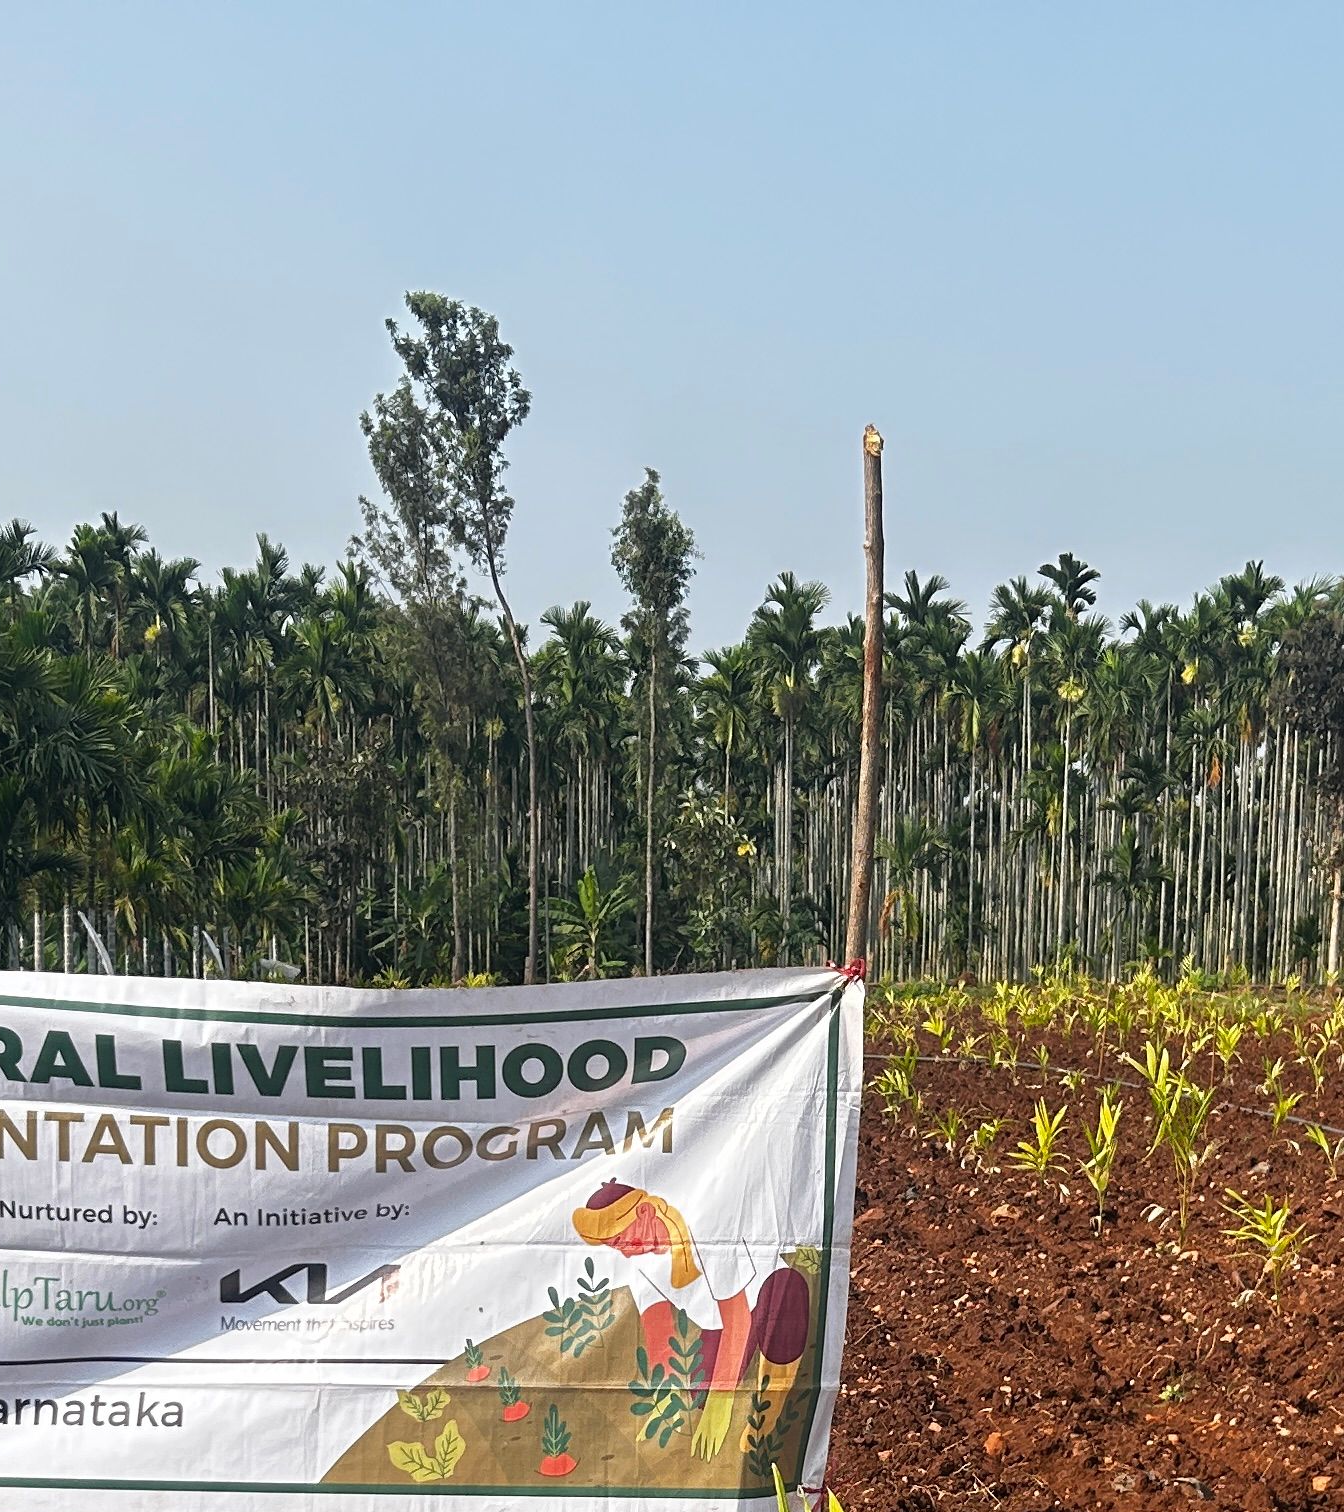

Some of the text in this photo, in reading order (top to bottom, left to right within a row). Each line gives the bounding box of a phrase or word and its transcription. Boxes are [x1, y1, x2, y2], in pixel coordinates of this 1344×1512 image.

[162, 1036, 687, 1100] LIVELIHOOD
[327, 1107, 674, 1173] PROGRAM
[0, 1200, 113, 1224] Nurtured
[123, 1205, 158, 1229] by:
[213, 1203, 410, 1226] An Initiative by:
[21, 1316, 44, 1326] We
[46, 1316, 79, 1327] don't
[81, 1317, 105, 1328] just
[220, 1316, 301, 1332] Movement
[341, 1317, 395, 1335] nspires
